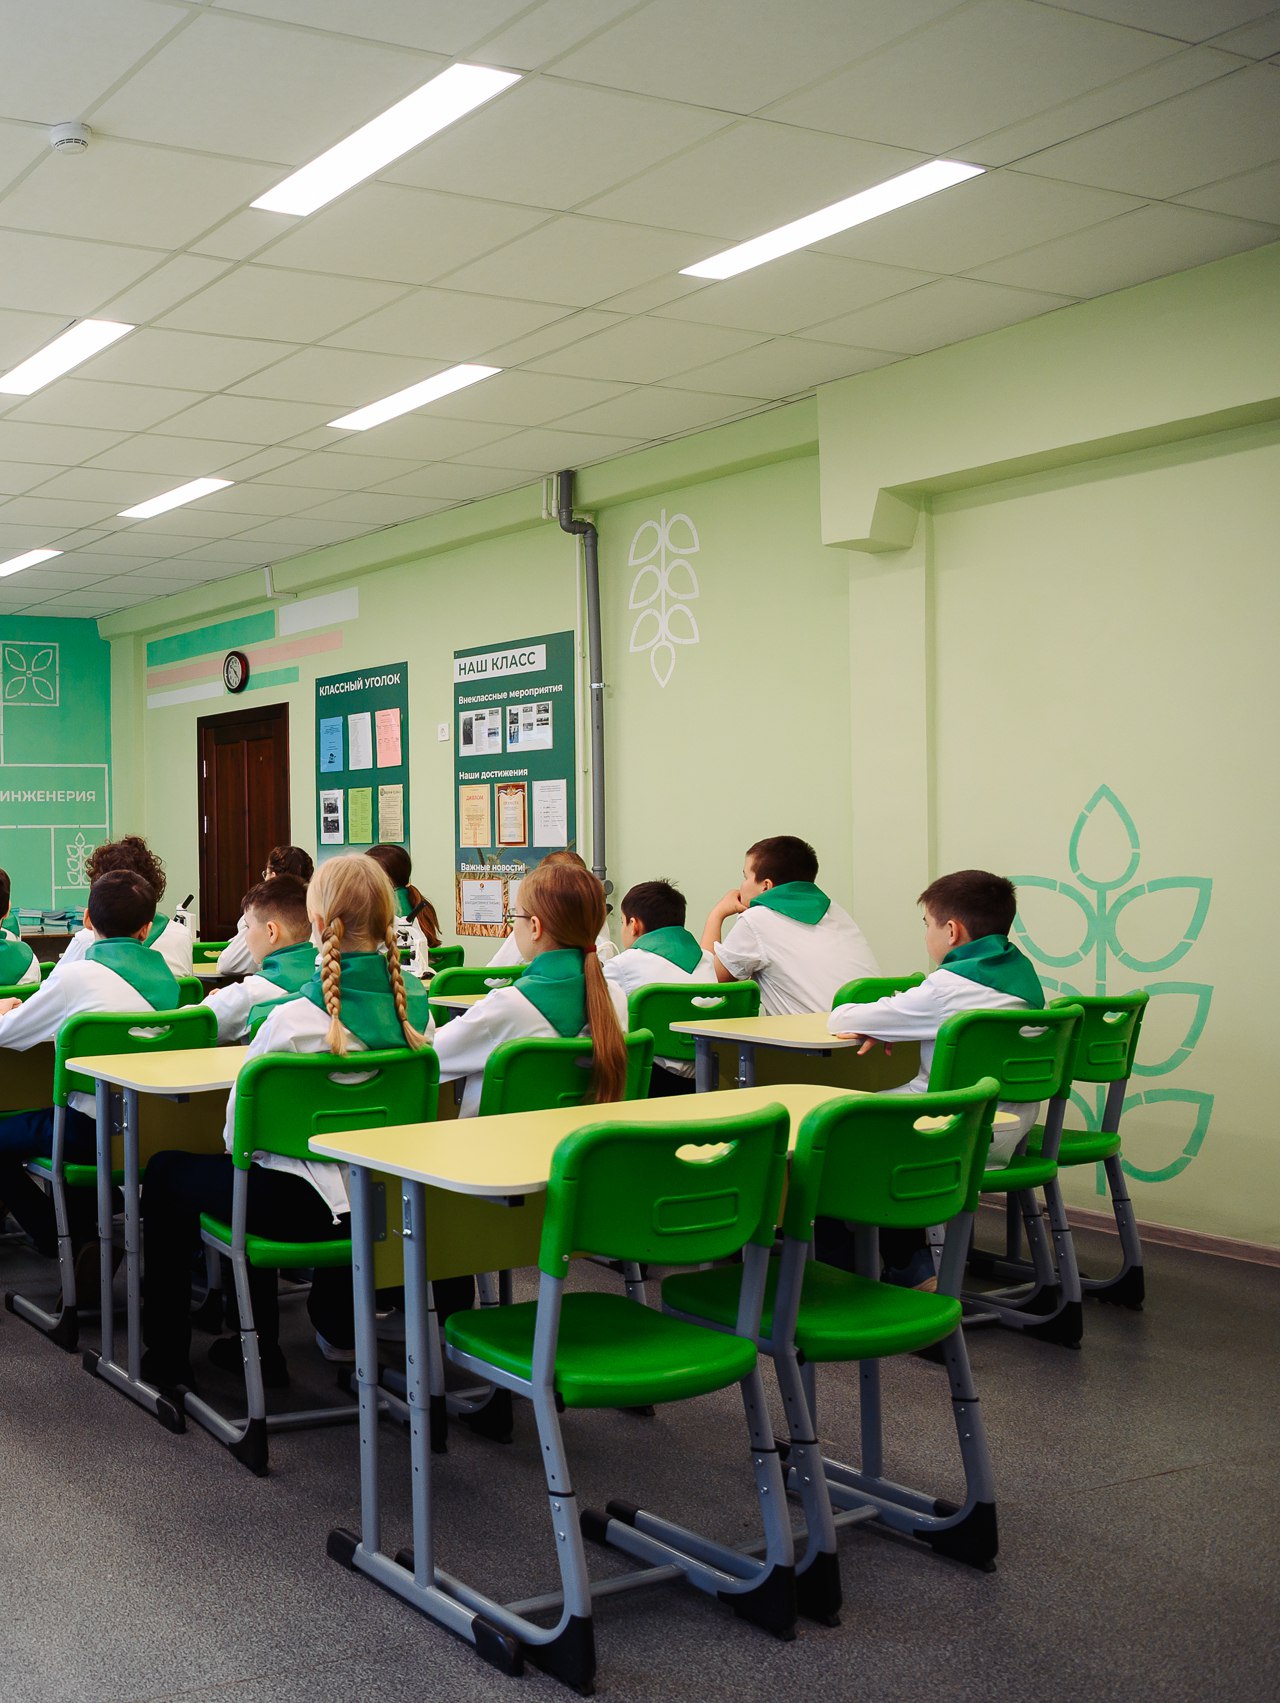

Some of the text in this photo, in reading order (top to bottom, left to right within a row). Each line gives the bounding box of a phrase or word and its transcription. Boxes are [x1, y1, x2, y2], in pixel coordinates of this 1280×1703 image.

[458, 651, 536, 676] НАШ КЛАСС
[319, 673, 401, 697] КЛАССНЫЙ УГОЛОК
[458, 684, 563, 705] Внеклассные мероприятия
[459, 768, 529, 780] Наши достижения
[461, 862, 526, 872] Важные новости!
